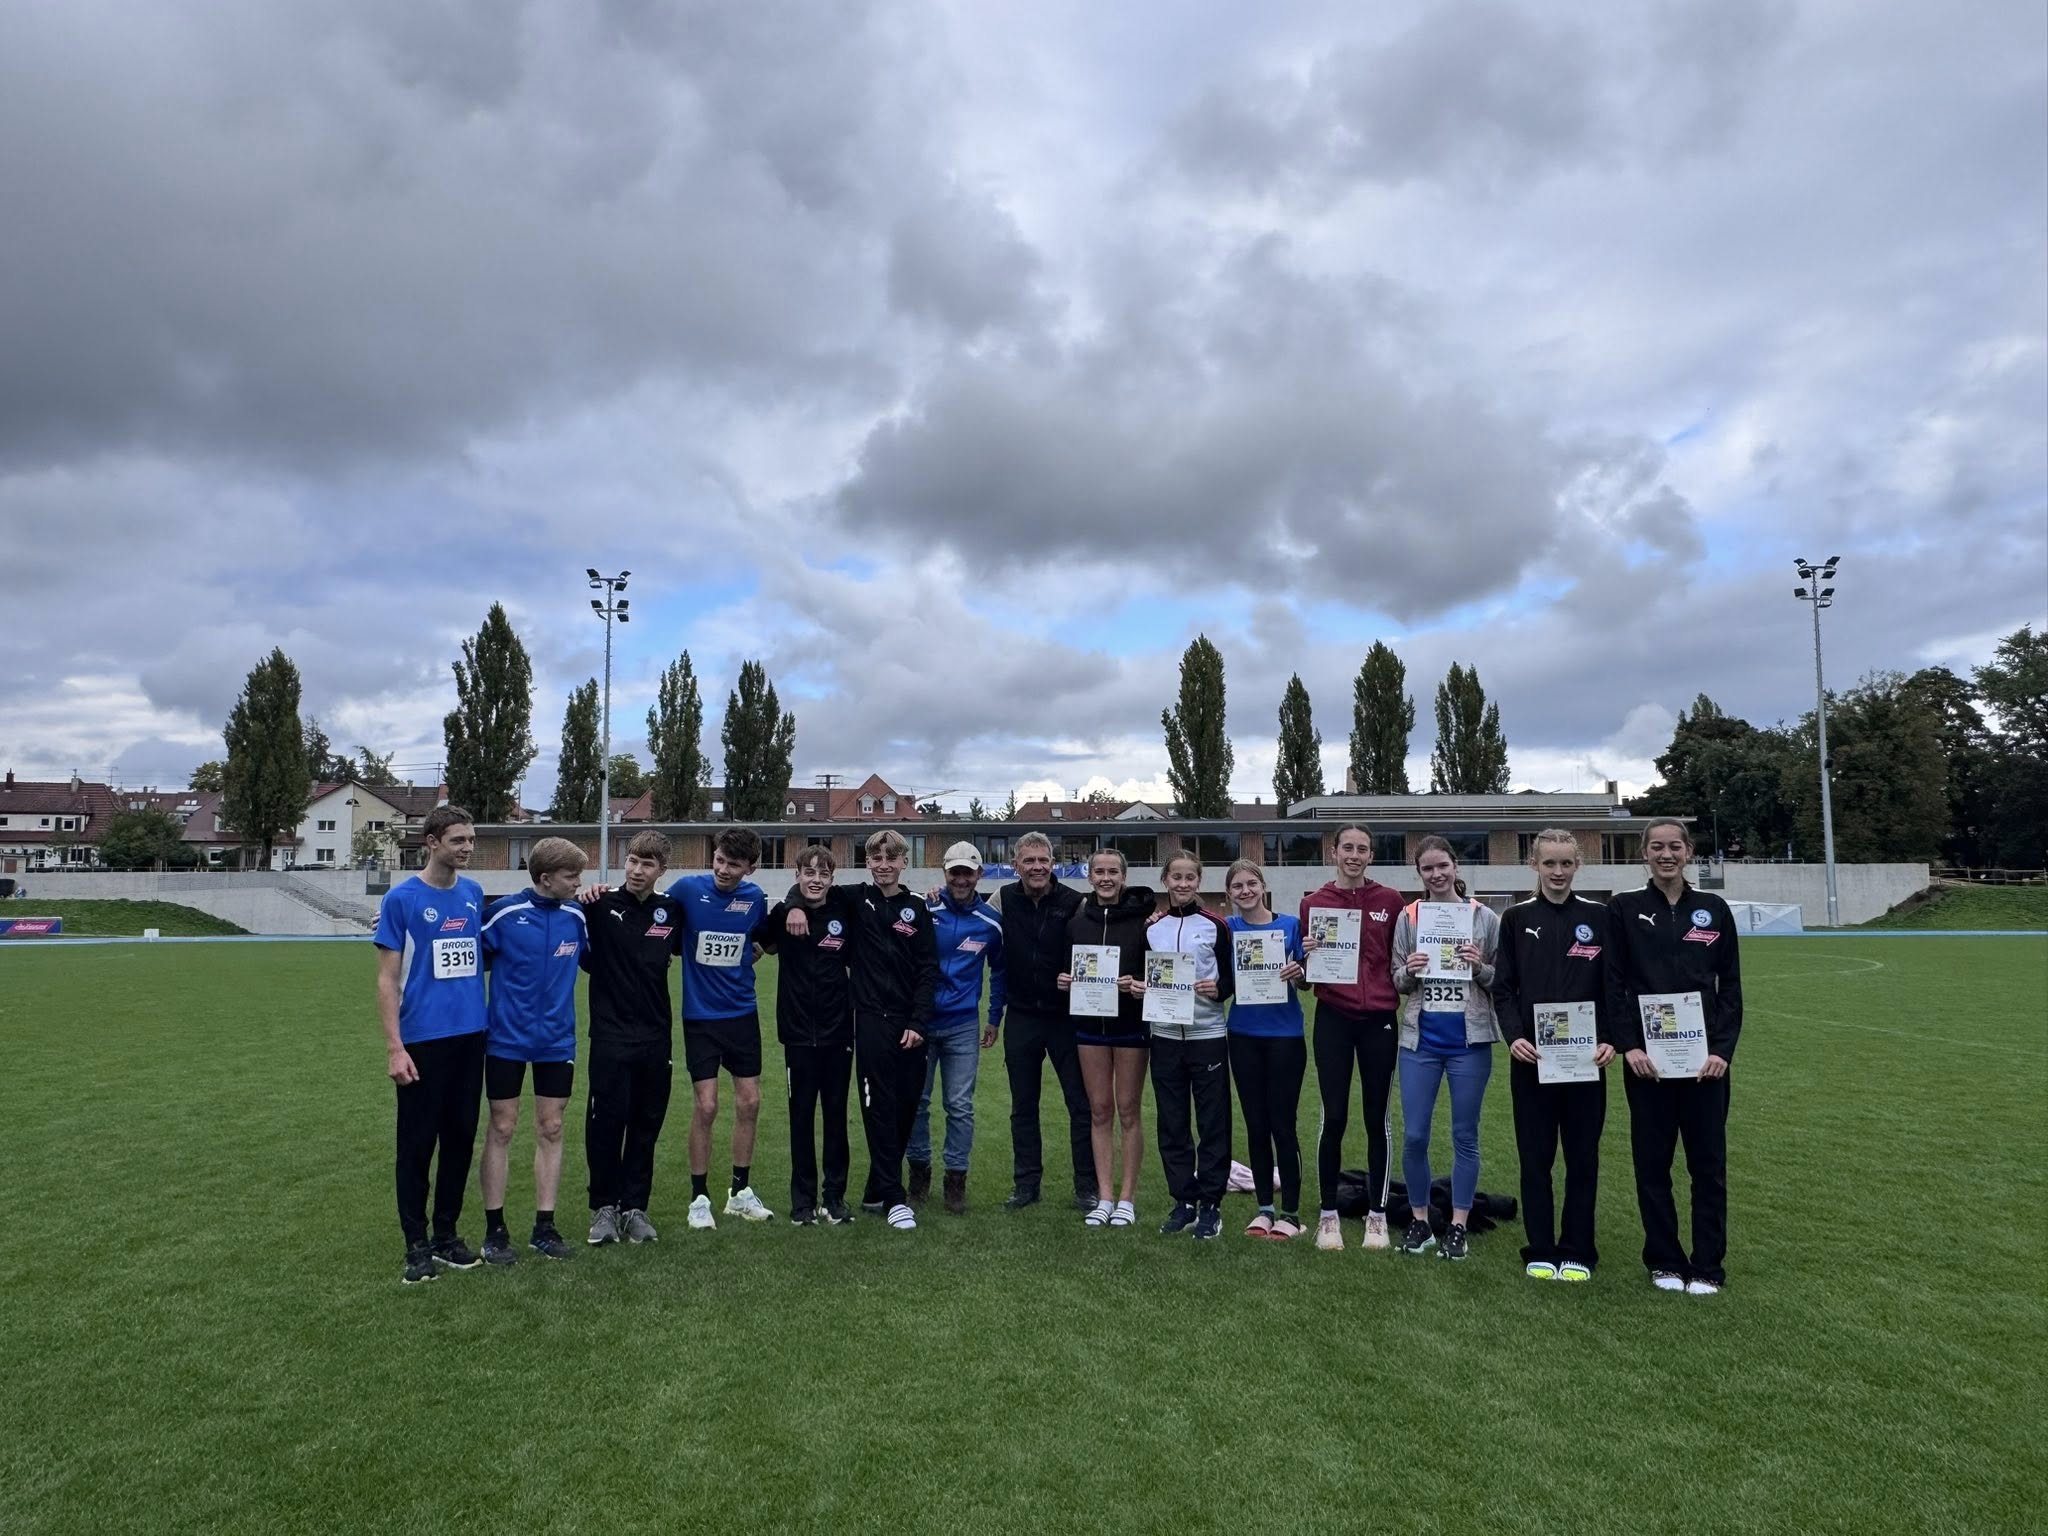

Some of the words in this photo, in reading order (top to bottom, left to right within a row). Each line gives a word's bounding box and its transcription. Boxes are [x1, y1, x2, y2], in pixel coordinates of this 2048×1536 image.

[441, 941, 474, 950] BROOKS
[705, 934, 741, 943] BROOKS
[703, 942, 739, 957] 3317
[441, 950, 475, 967] 3319
[1424, 986, 1464, 1002] 3325
